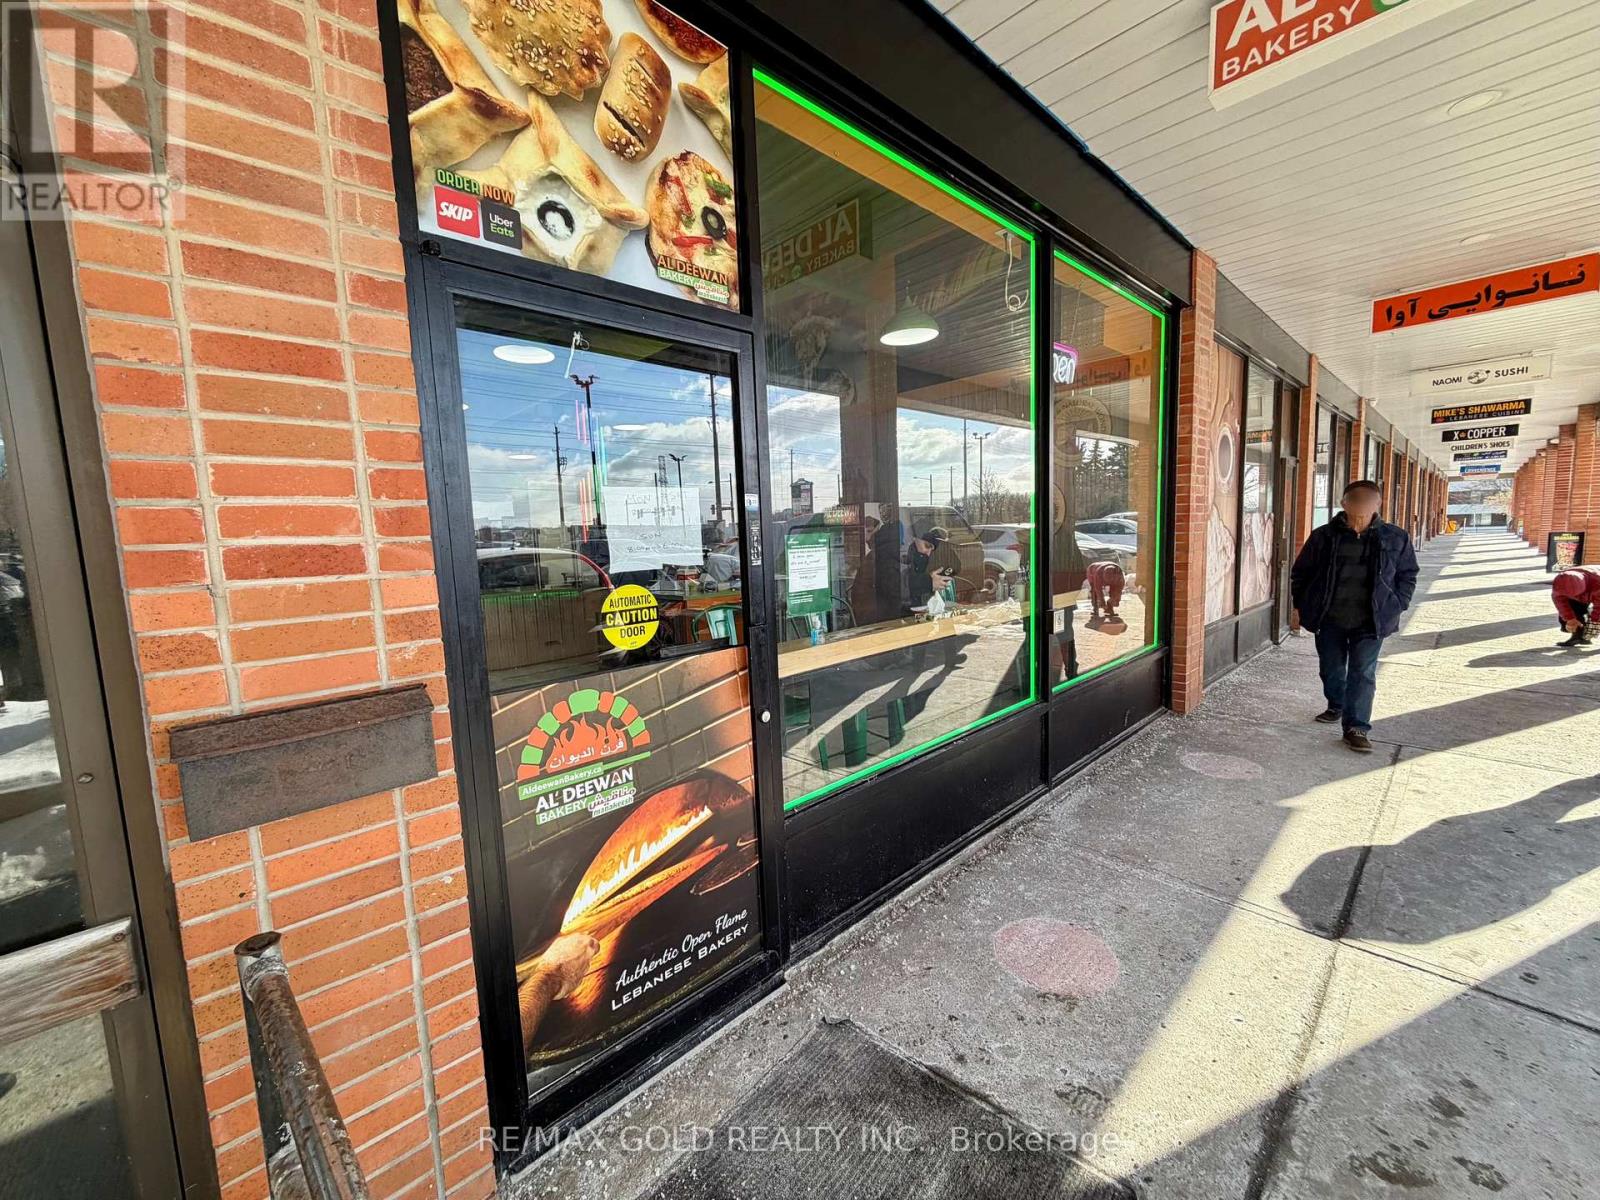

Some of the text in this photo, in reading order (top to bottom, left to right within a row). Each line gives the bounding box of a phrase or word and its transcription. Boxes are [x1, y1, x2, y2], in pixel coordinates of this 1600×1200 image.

[1223, 0, 1362, 81] BAKERY
[437, 169, 515, 205] ORDER NOW
[439, 202, 473, 222] SKIP
[489, 213, 514, 228] Uber
[490, 224, 515, 238] Eats
[659, 268, 695, 287] BAKERY
[677, 260, 728, 285] DEEWAN
[1385, 297, 1422, 328] آوا
[1432, 376, 1463, 386] NAOMI
[1494, 366, 1529, 378] SUSHI
[1433, 401, 1526, 418] MIKE'S SHAWARMA
[1453, 426, 1507, 441] X COPPER
[1450, 440, 1511, 452] CHILDREN'S SHOES
[609, 594, 652, 609] AUTOMATIC
[606, 607, 657, 626] CAUTION
[620, 625, 646, 639] DOOR
[522, 766, 602, 796] AldeewanBakery.ca
[562, 766, 633, 804] DEEWAN
[539, 798, 588, 825] BAKERY
[616, 909, 748, 992] Authentic Open Flame
[611, 923, 749, 1011] LEBANESE BAKERY
